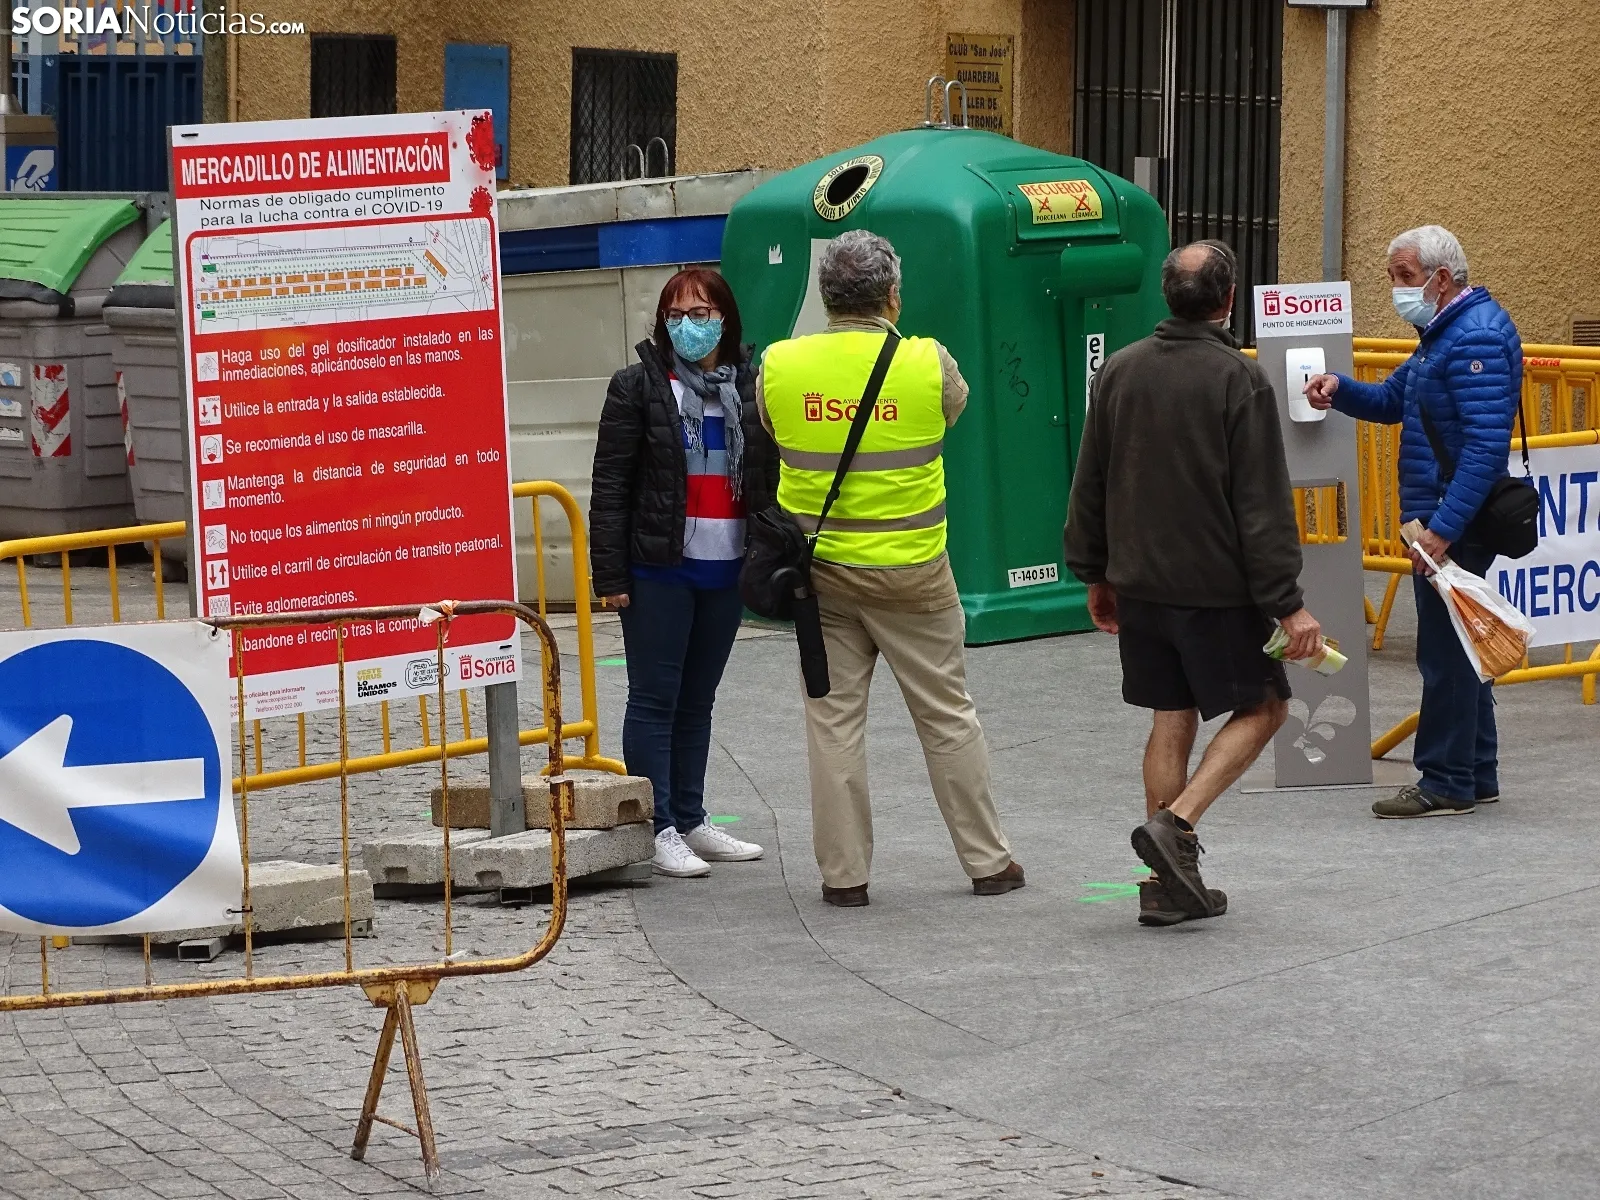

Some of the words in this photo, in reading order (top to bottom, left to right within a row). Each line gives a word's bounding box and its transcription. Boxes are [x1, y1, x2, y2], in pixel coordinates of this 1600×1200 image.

[949, 44, 968, 56] CLUB
[957, 70, 1000, 84] GUARDERIA
[958, 96, 985, 109] TLLER
[987, 97, 998, 111] DE
[181, 152, 294, 186] MERCADILLO
[299, 151, 322, 179] DE
[326, 138, 444, 178] ALIMENTACIÓN
[827, 165, 844, 179] SOLO
[200, 197, 260, 211] Normas
[265, 194, 284, 207] de
[289, 190, 351, 207] obligado
[355, 185, 446, 205] cumplimento
[1020, 181, 1093, 196] RECUERDA
[200, 213, 235, 229] para
[240, 211, 254, 224] la
[259, 208, 299, 222] lucha
[304, 206, 350, 220] contra
[354, 204, 367, 216] el
[371, 199, 443, 216] COVID-19
[838, 206, 845, 217] DE
[847, 187, 867, 210] VIDRIO
[1036, 213, 1067, 222] PORCELANA
[1284, 295, 1343, 315] Soria
[1262, 321, 1285, 329] PUNTO
[1285, 320, 1295, 328] DE
[1295, 317, 1343, 327] HIGIENIZACIÓN
[221, 348, 252, 366] Haga
[260, 347, 281, 360] uso
[288, 342, 305, 358] del
[312, 340, 330, 358] gel
[336, 335, 397, 355] dosificador
[403, 332, 451, 349] instalado
[458, 331, 472, 343] en
[478, 327, 494, 341] las
[222, 362, 307, 382] inmediaciones,
[310, 352, 386, 376] aplicándoselo
[389, 354, 403, 367] en
[405, 351, 422, 365] las
[425, 348, 463, 363] manos.
[224, 401, 260, 418] Utilice
[263, 398, 273, 414] la
[277, 395, 320, 413] entrada
[322, 398, 329, 411] y
[332, 392, 343, 408] la
[345, 388, 379, 406] salida
[381, 384, 446, 403] establecida.
[825, 398, 898, 422] Soia
[226, 439, 242, 455] Se
[245, 432, 312, 452] recomienda
[314, 431, 325, 446] el
[328, 430, 348, 444] uso
[351, 427, 365, 441] de
[368, 422, 427, 440] mascarilla.
[228, 474, 284, 492] Mantenga
[293, 469, 304, 483] la
[312, 459, 362, 481] distancia
[371, 460, 385, 475] de
[394, 453, 446, 475] seguridad
[455, 453, 468, 466] en
[477, 449, 500, 463] todo
[228, 491, 285, 509] momento.
[230, 529, 247, 545] No
[250, 526, 282, 544] toque
[285, 523, 302, 538] los
[305, 518, 359, 537] alimentos
[362, 514, 372, 530] ni
[375, 510, 412, 530] ningún
[414, 505, 465, 527] producto.
[232, 564, 268, 581] Utilice
[271, 561, 282, 576] el
[285, 557, 313, 574] carril
[316, 556, 330, 571] de
[333, 548, 392, 568] circulación
[395, 546, 409, 560] de
[412, 540, 452, 559] transito
[454, 534, 504, 556] peatonal.
[1498, 559, 1600, 618] MERC
[234, 601, 264, 617] Evite
[267, 589, 358, 613] aglomeraciones.
[240, 631, 293, 652] bandone
[297, 630, 308, 645] el
[310, 626, 348, 643] recino
[351, 622, 373, 638] tras
[375, 619, 386, 635] la
[357, 673, 382, 682] VIRUS
[474, 659, 516, 678] Soria
[357, 688, 389, 698] UNIDOS
